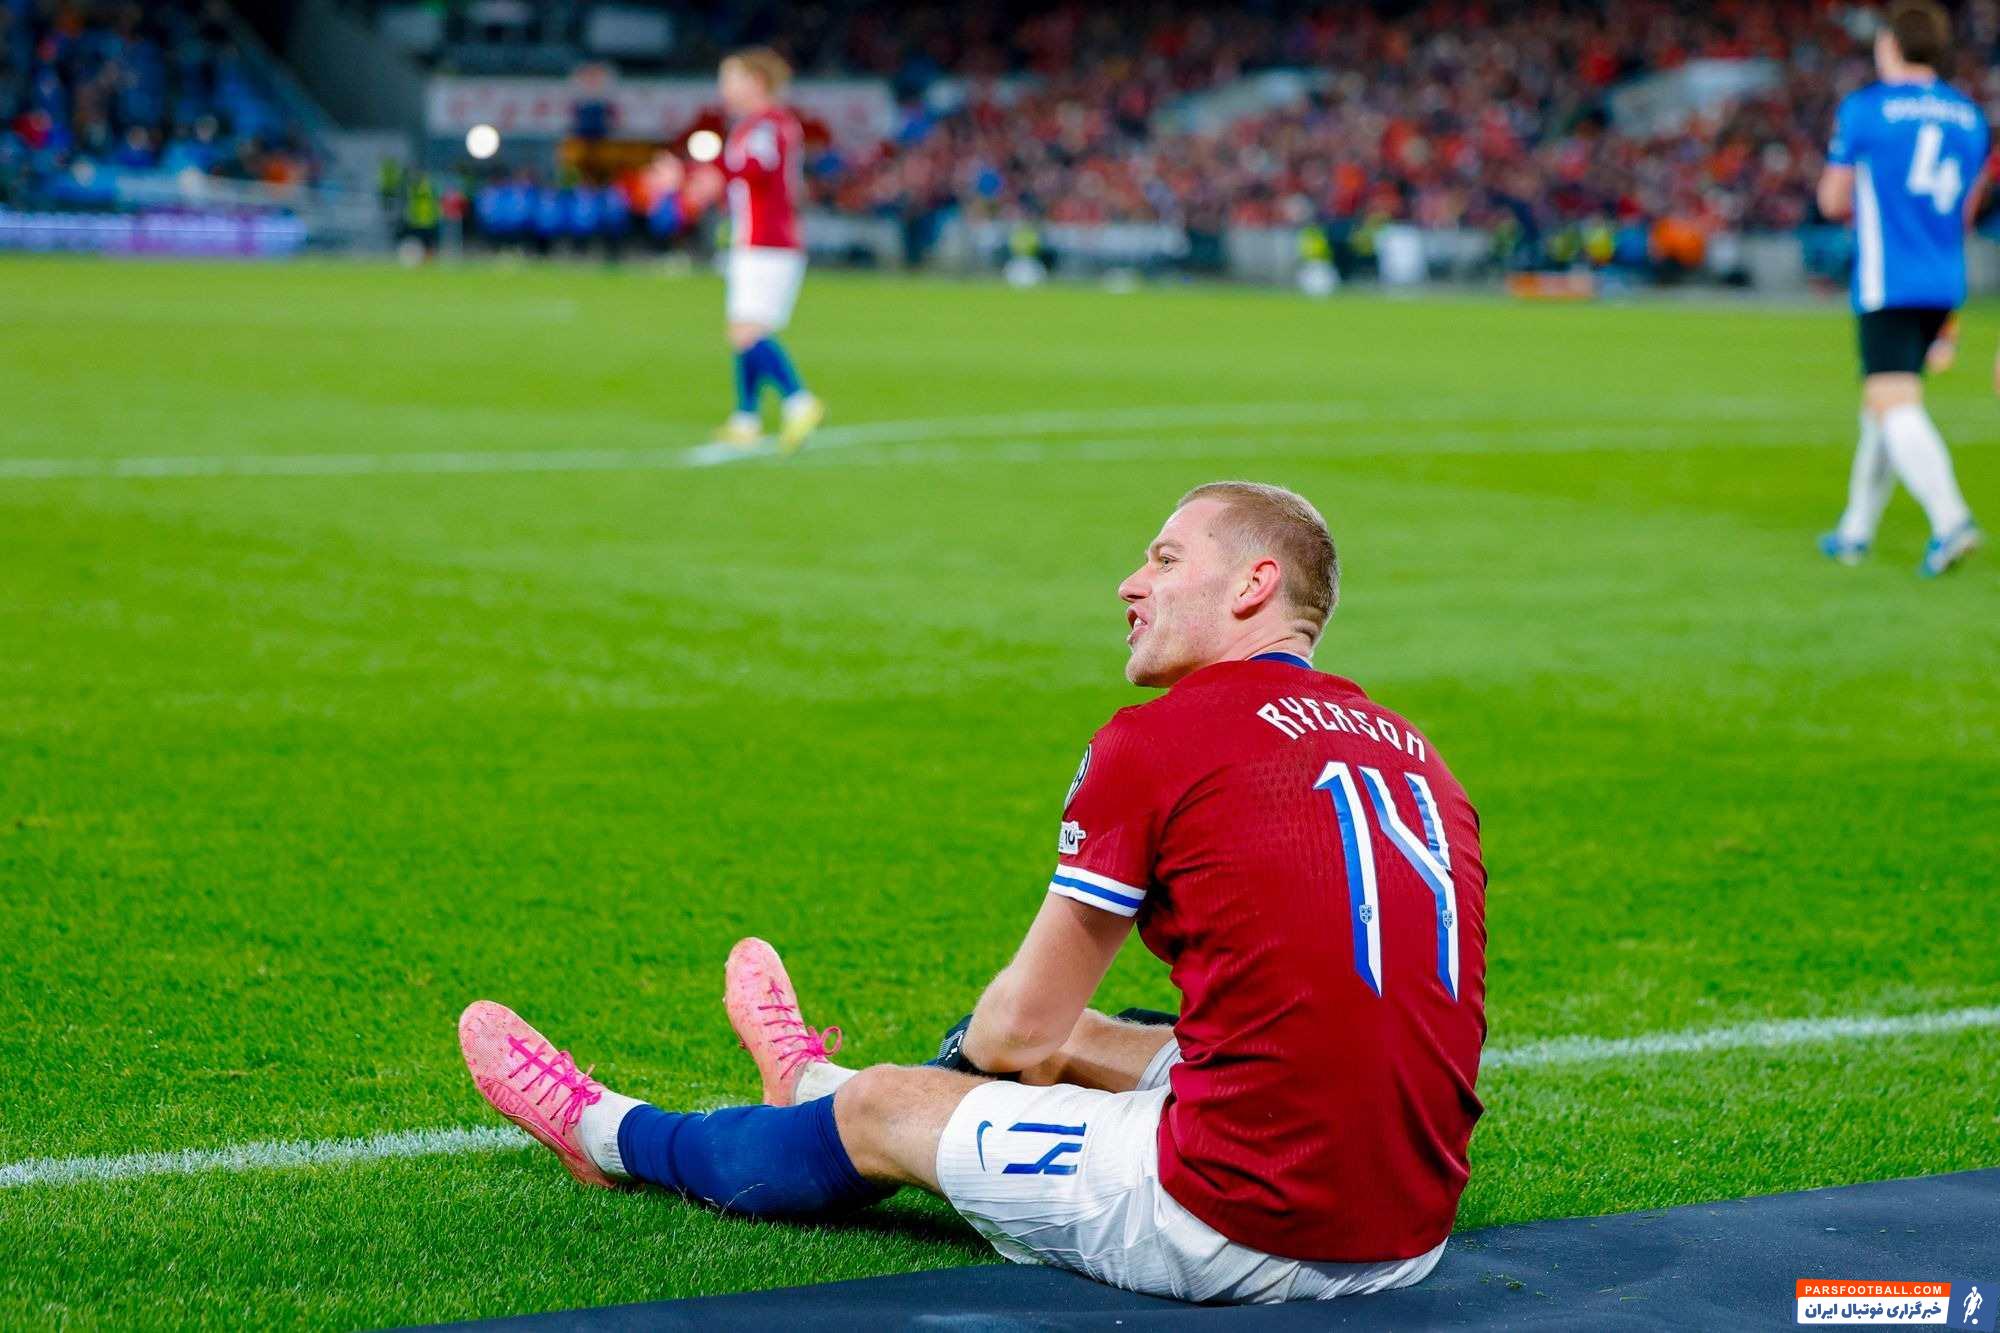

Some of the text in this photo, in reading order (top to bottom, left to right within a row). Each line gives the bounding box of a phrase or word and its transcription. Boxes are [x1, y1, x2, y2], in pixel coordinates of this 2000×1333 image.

[1906, 122, 1963, 215] 4
[1256, 697, 1425, 763] RYERSON
[1313, 760, 1460, 1003] 14
[1001, 1121, 1087, 1176] 14
